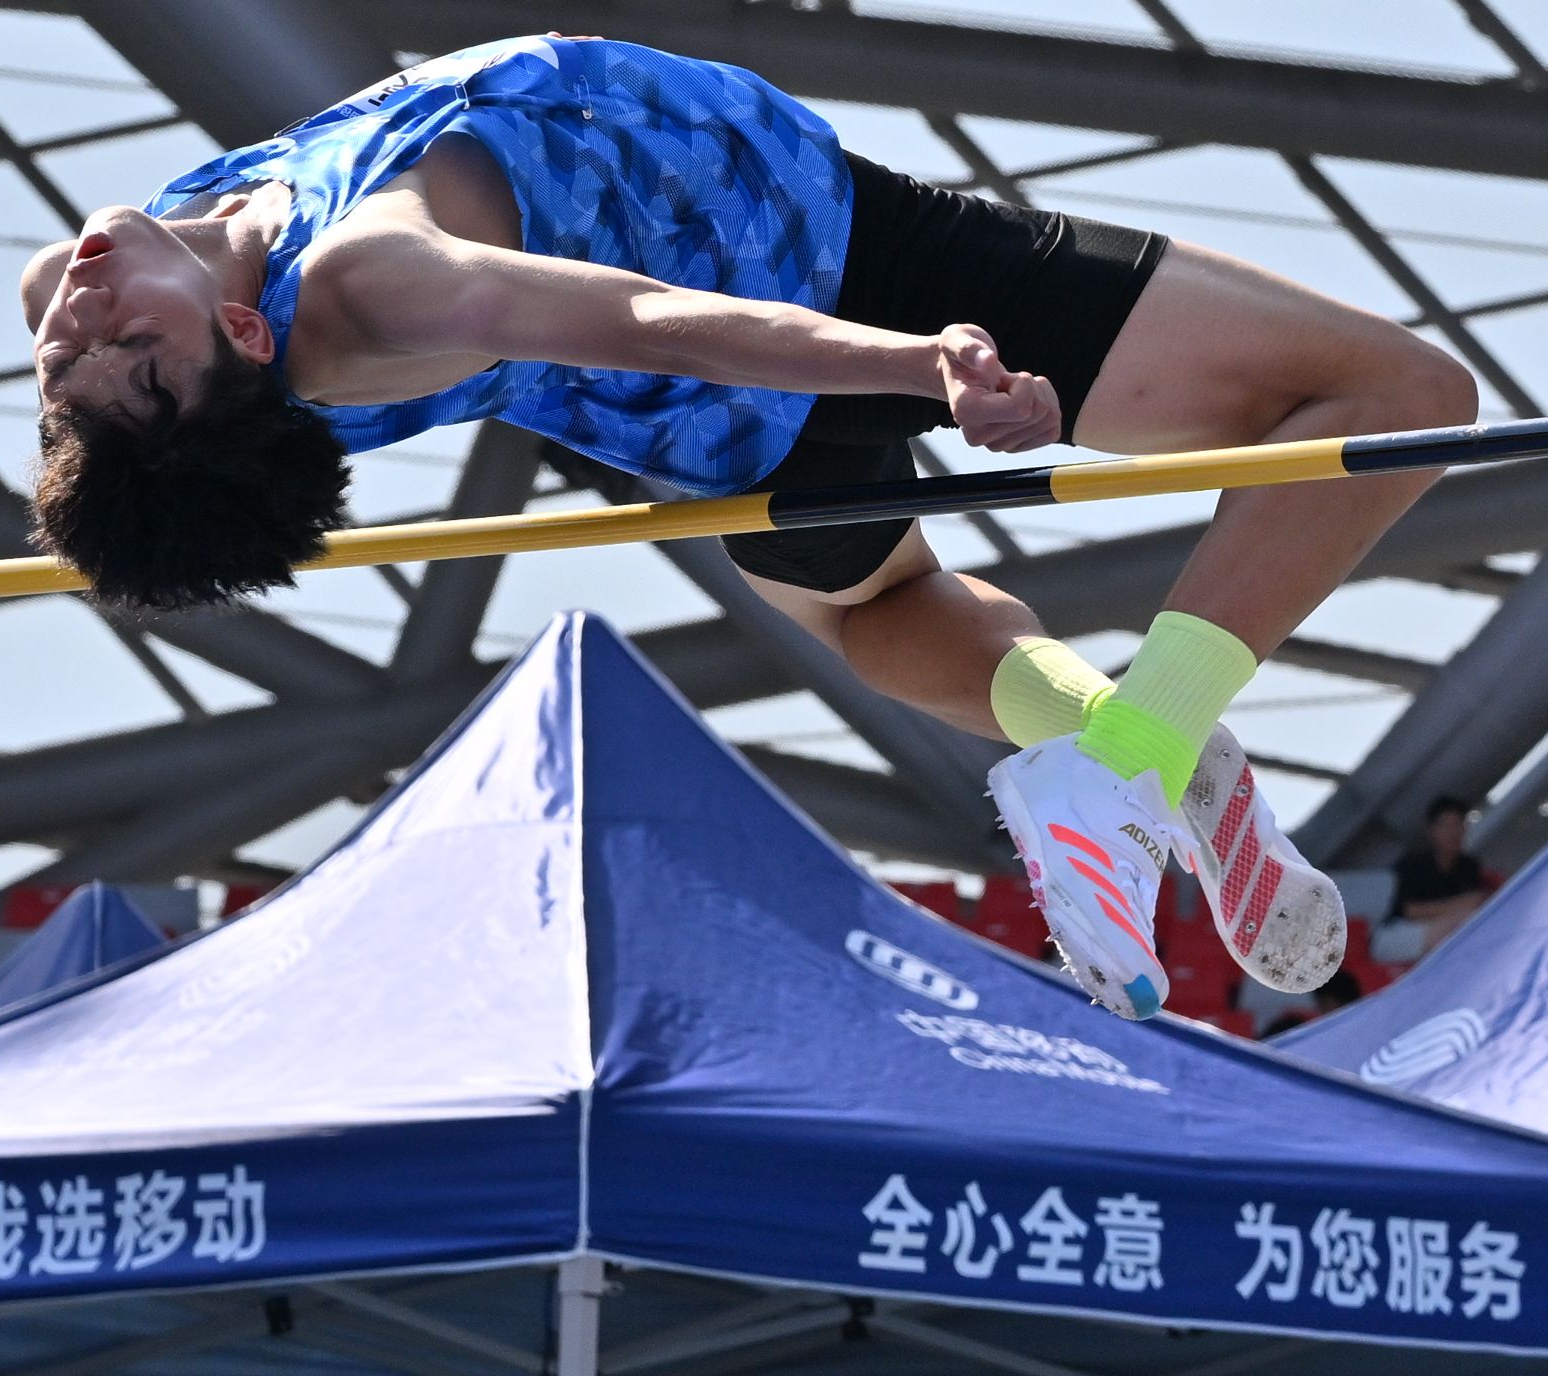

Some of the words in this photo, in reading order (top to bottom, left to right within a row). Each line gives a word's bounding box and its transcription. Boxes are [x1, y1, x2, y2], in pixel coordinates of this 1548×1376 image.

[858, 1174, 1164, 1292] 全心全意
[1234, 1202, 1526, 1321] 为您服务
